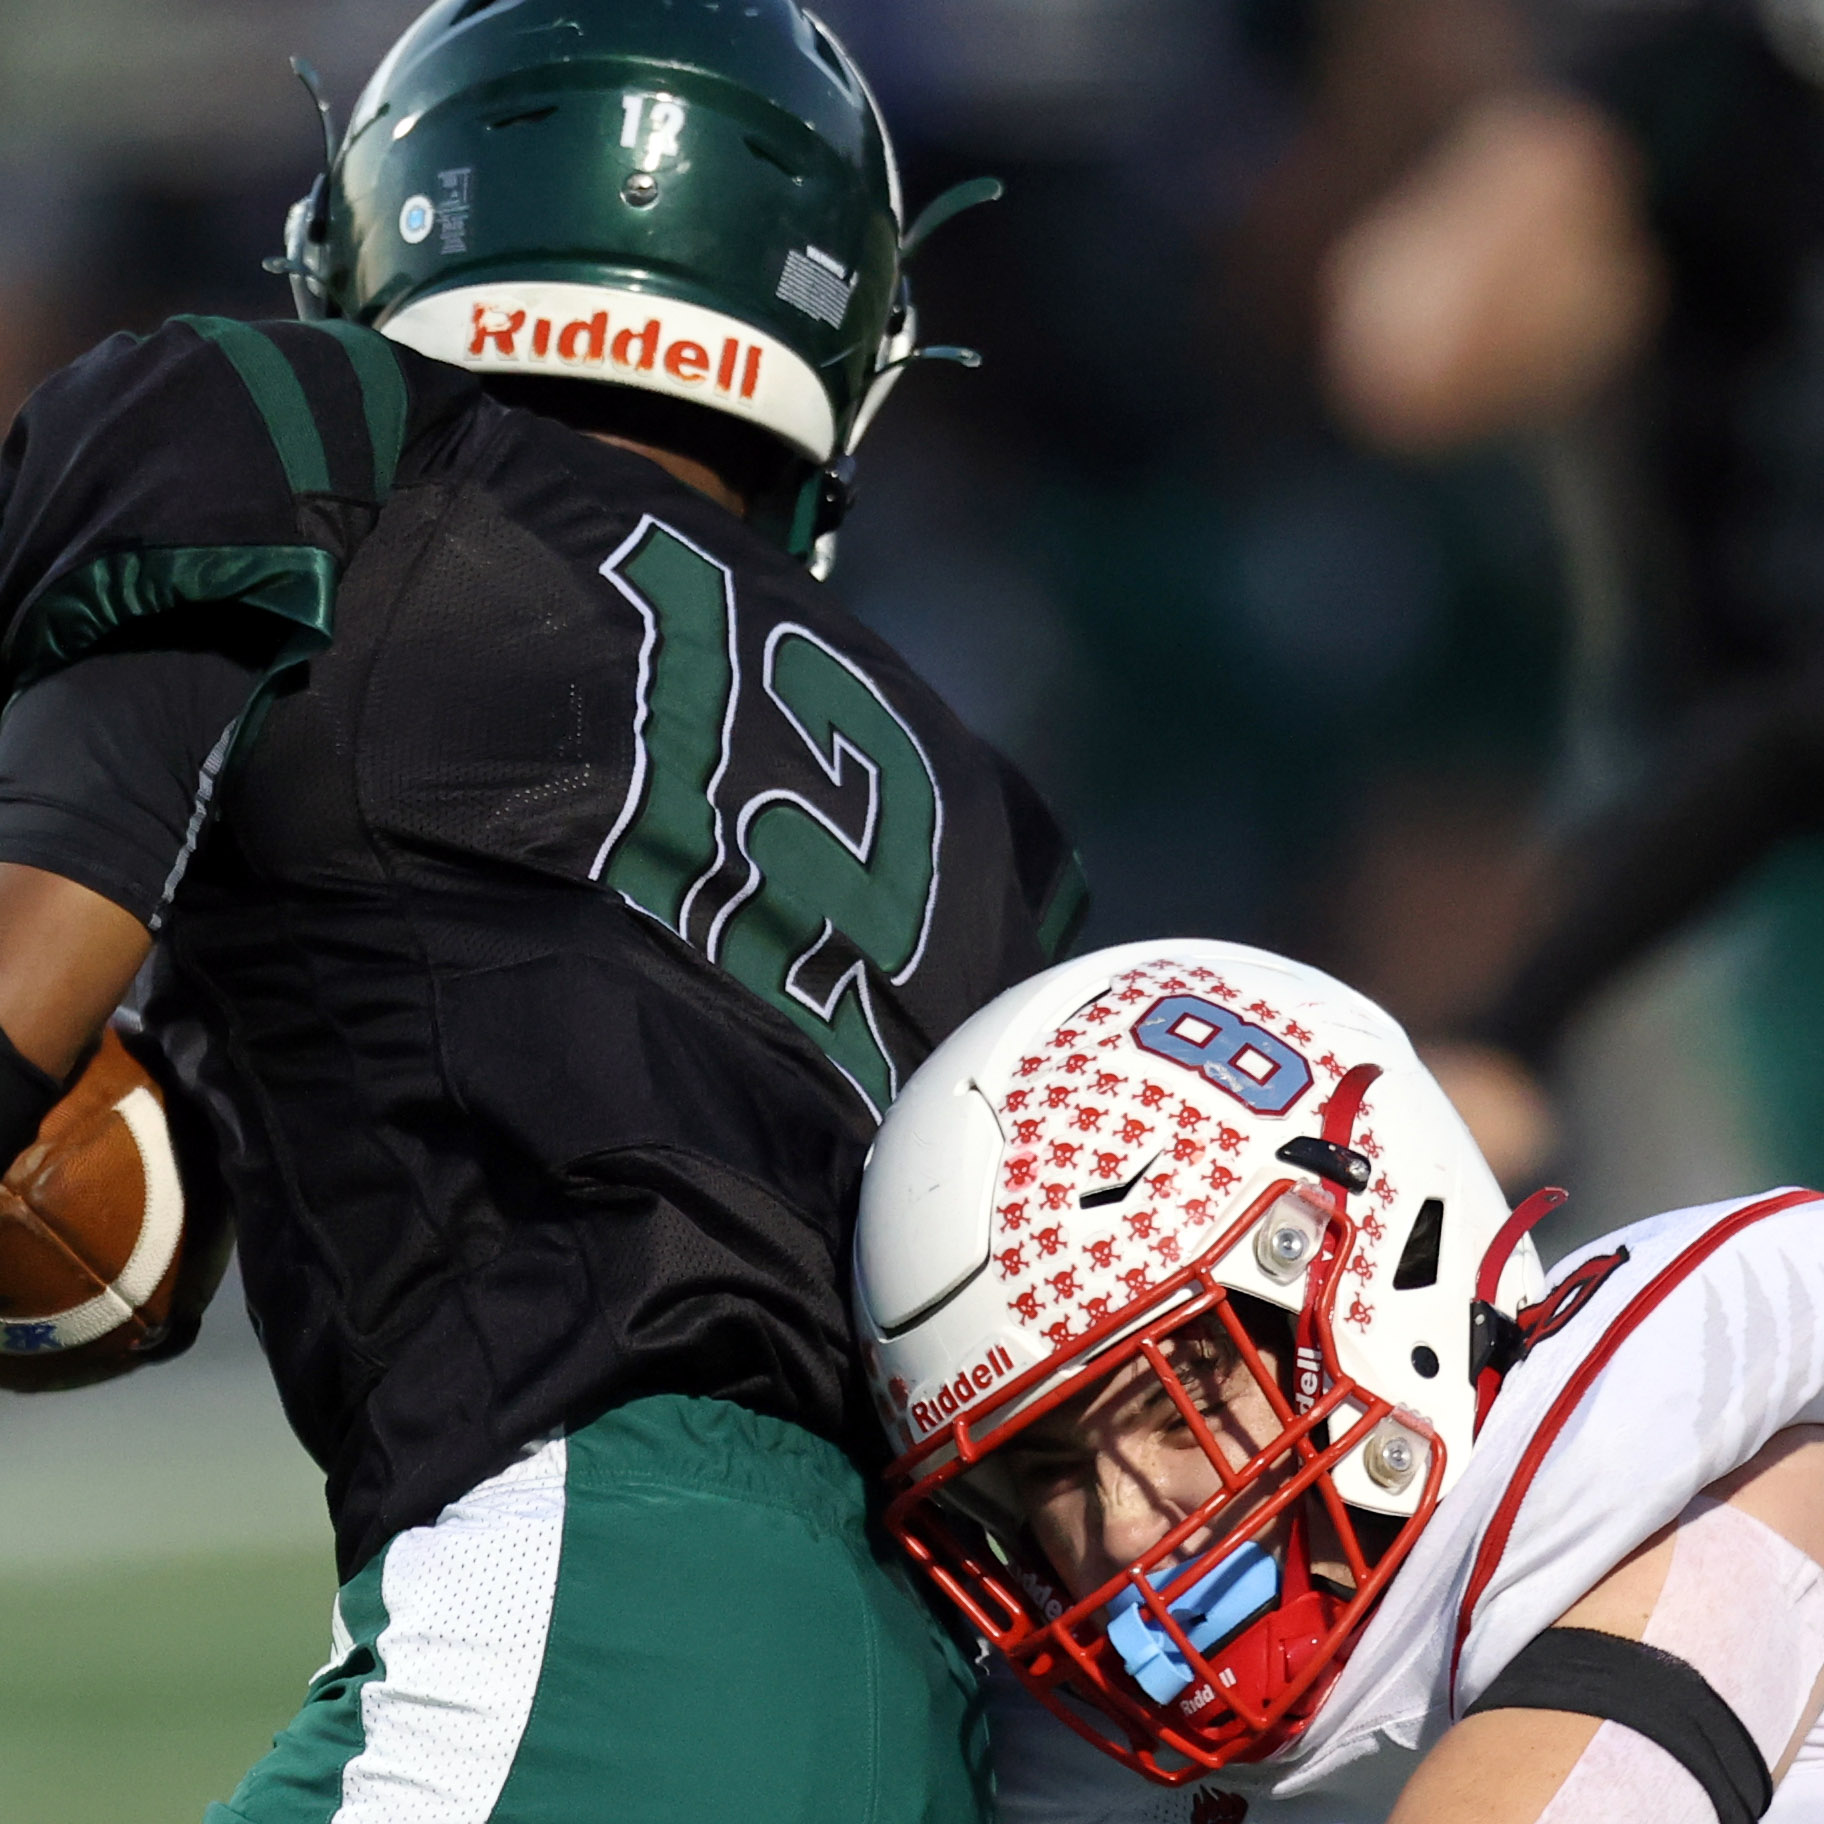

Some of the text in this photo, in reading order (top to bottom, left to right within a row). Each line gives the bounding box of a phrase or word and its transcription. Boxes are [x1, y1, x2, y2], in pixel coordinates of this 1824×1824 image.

[619, 94, 685, 156] 12
[466, 301, 763, 401] Riddell
[587, 513, 943, 1125] 12
[1129, 991, 1315, 1117] 8
[911, 1345, 1014, 1434] Riddell
[1179, 1666, 1237, 1716] Riddll
